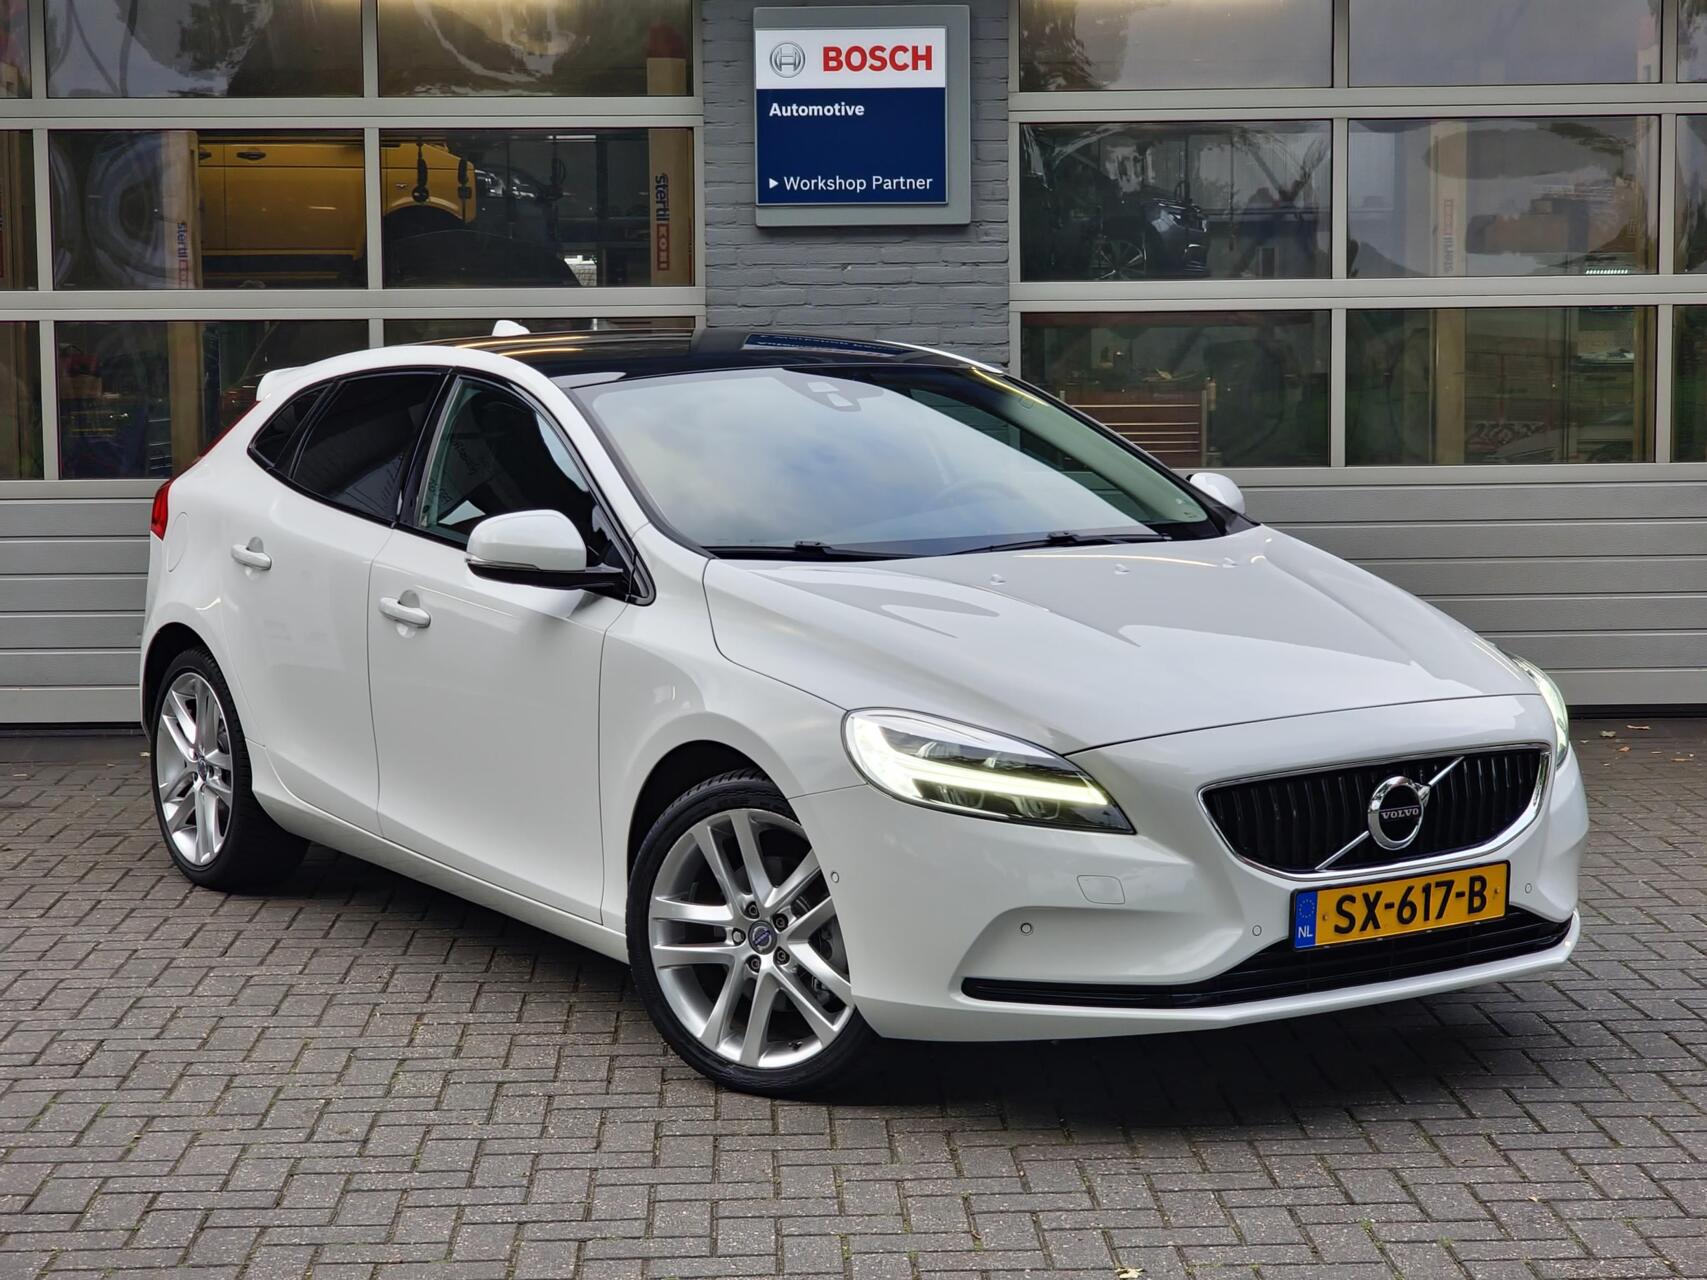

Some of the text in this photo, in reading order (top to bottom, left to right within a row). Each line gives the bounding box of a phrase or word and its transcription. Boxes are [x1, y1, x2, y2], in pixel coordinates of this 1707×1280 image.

[822, 45, 933, 72] BOSCH
[769, 102, 865, 117] Automotive
[783, 175, 933, 193] Workshop Partner
[655, 175, 669, 221] stertil
[1380, 807, 1420, 820] VOLVO
[1333, 874, 1488, 935] SX-617-B
[1297, 926, 1313, 939] NL
